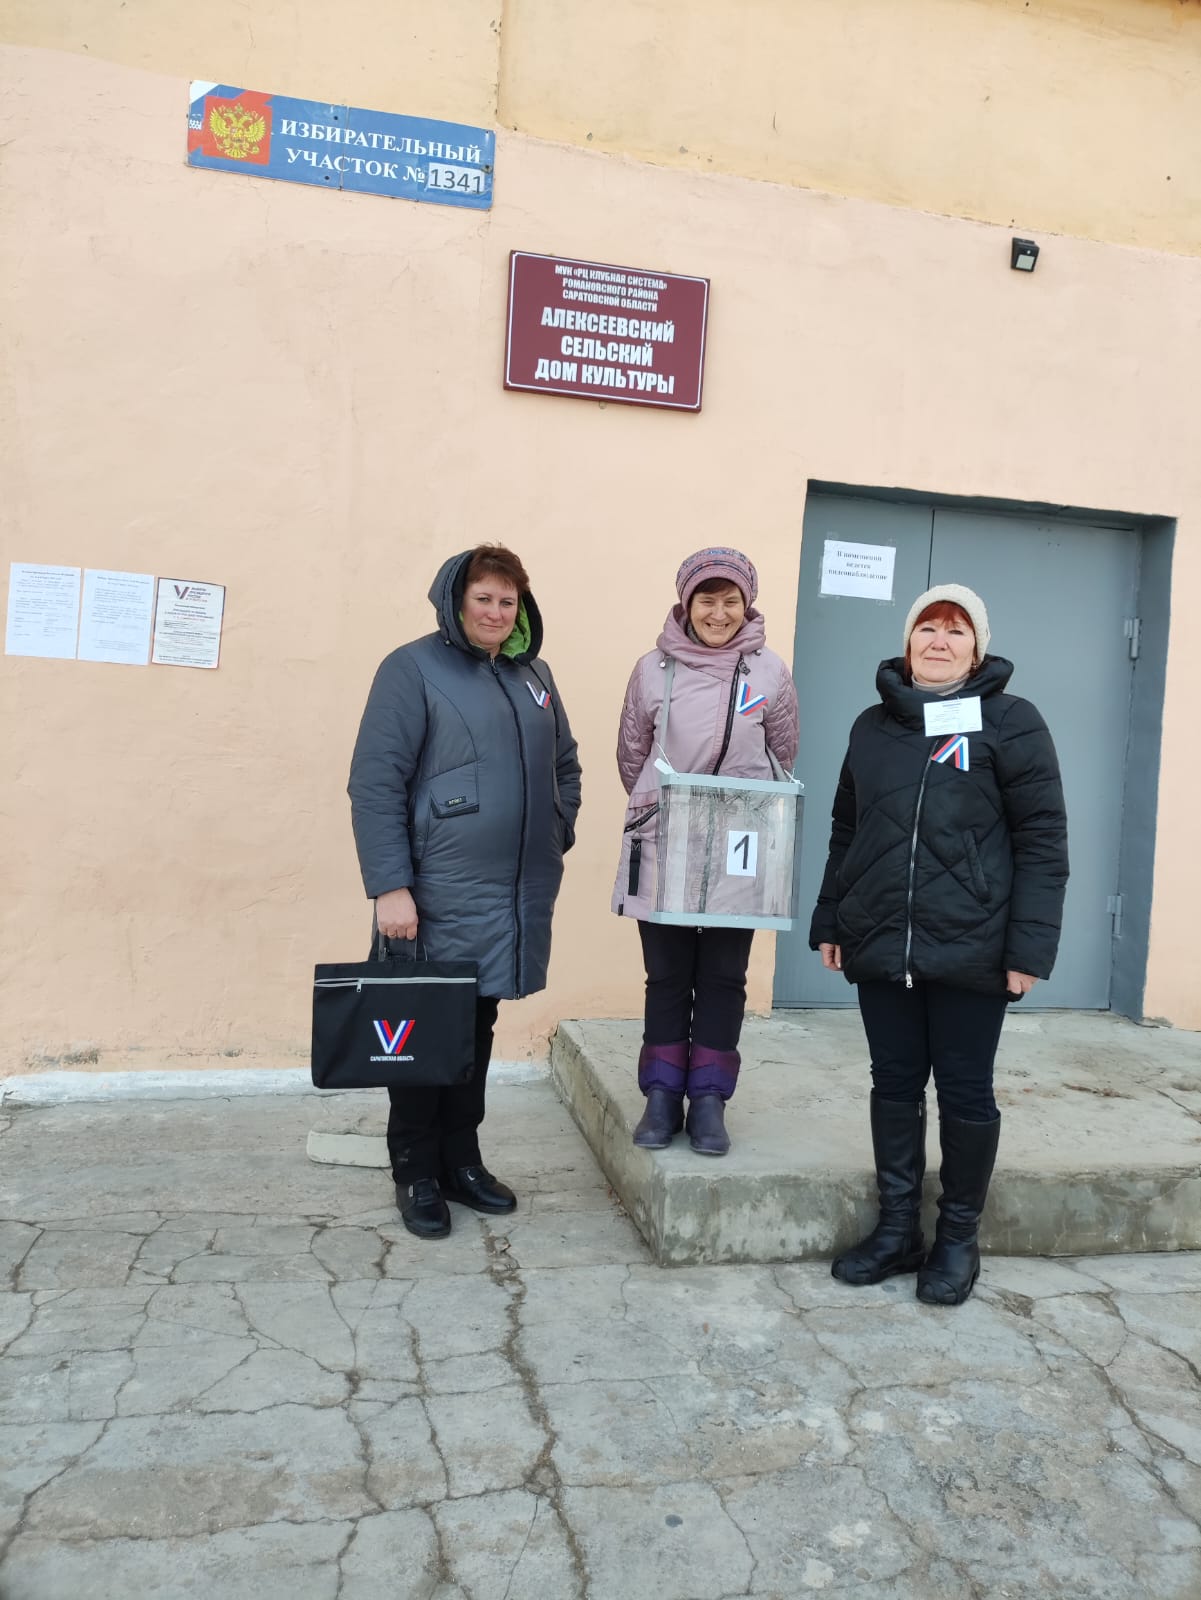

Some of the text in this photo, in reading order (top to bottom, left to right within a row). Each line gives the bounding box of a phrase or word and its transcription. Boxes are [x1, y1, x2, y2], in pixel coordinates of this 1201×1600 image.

[280, 118, 482, 163] ИЗБИРАТЕЛЬНЫЙ
[285, 147, 485, 194] УЧАСТОК № 1341
[555, 264, 573, 276] МУК
[589, 270, 626, 284] КЛУБНАЯ
[627, 273, 668, 290] СИСТЕМА»
[562, 279, 659, 301] РОМАНОВСКОГО РАЙОНА
[562, 290, 658, 312] САРАТОВСКОЙ ОБЛАСТИ
[541, 306, 675, 343] АЛЕКСЕЕВСКИЙ
[561, 335, 654, 367] СЕЛЬСКИЙ
[535, 359, 675, 395] ДОМ КУЛЬТУРЫ
[734, 834, 750, 870] 1
